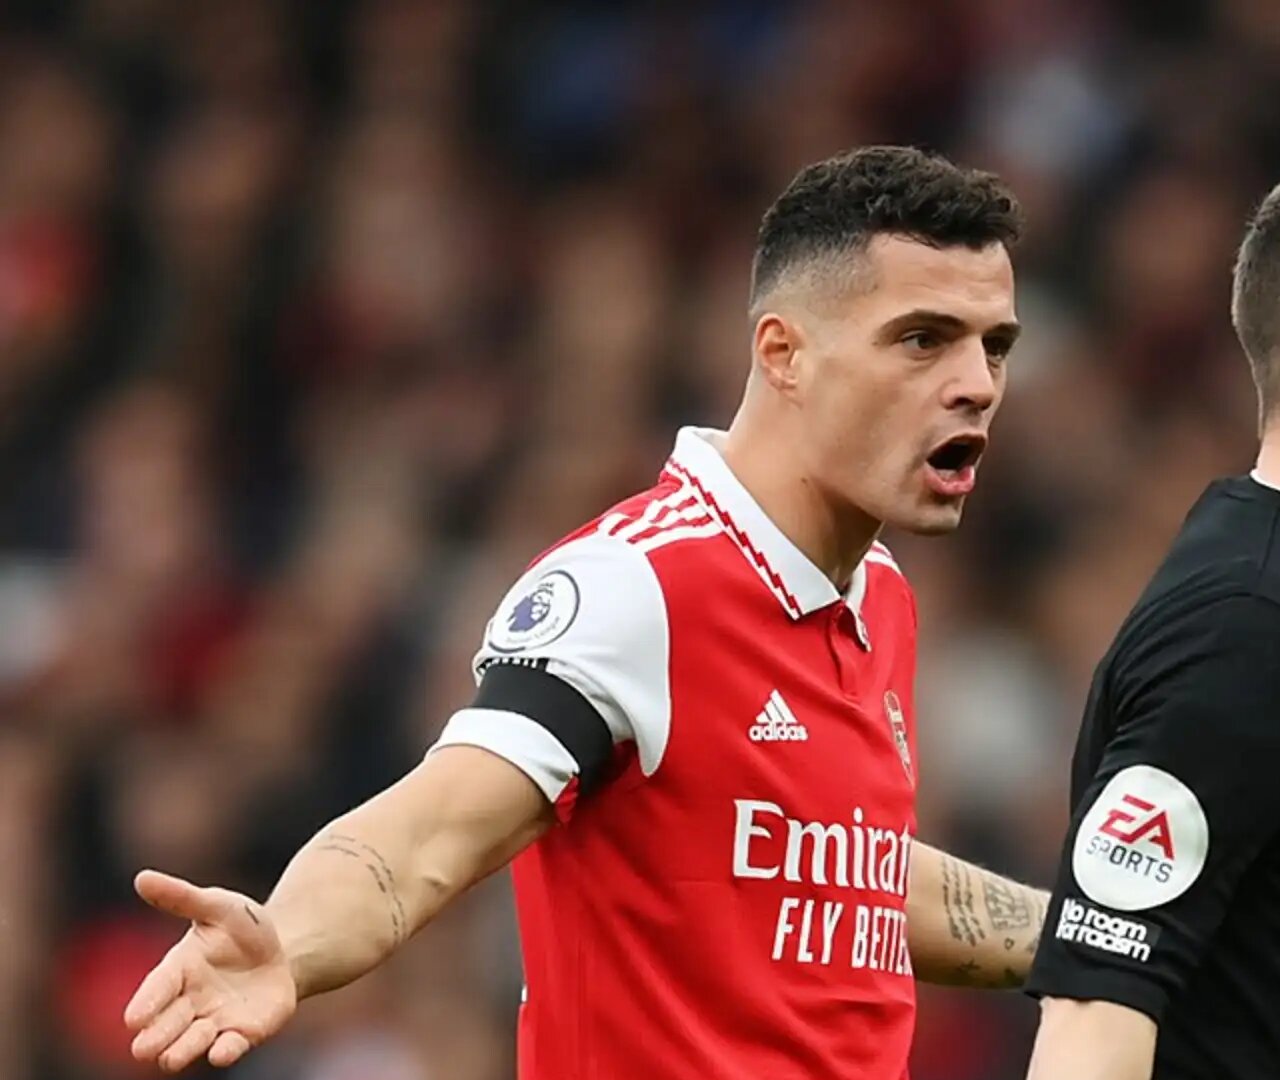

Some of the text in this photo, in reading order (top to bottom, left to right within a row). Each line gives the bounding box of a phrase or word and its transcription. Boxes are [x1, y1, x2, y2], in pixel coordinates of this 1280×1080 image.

[748, 721, 808, 741] adidas
[1098, 794, 1175, 861] EA
[1086, 835, 1173, 883] SPORTS
[771, 897, 844, 965] FLY
[1084, 908, 1147, 941] room
